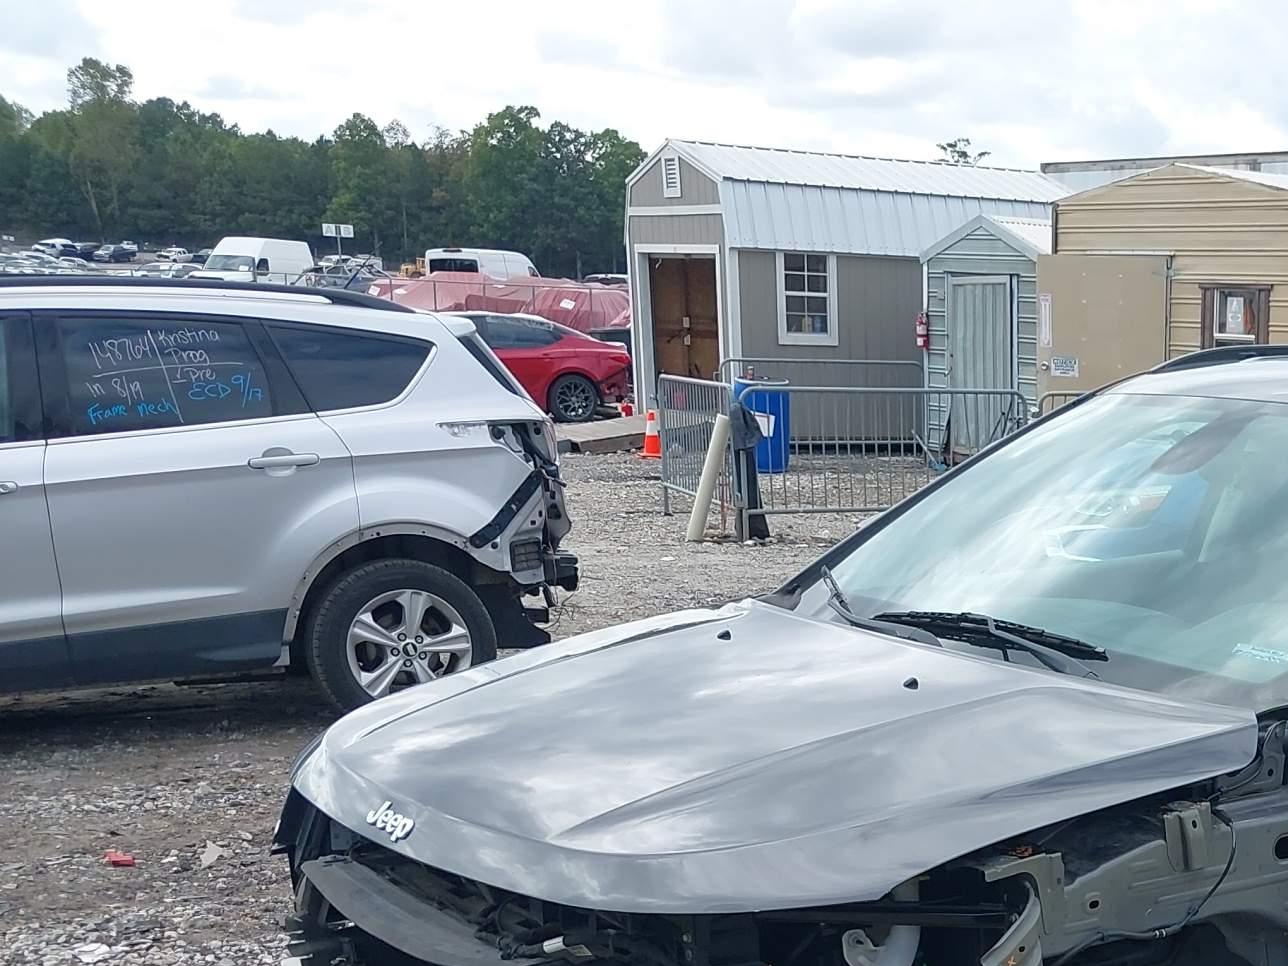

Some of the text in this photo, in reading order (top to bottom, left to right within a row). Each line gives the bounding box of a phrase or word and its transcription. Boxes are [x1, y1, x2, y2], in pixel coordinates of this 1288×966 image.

[89, 328, 220, 369] 148764 Kristina
[164, 347, 210, 365] Prog
[112, 374, 144, 405] 8/19
[88, 403, 128, 425] Frame
[366, 800, 415, 842] Jeep
